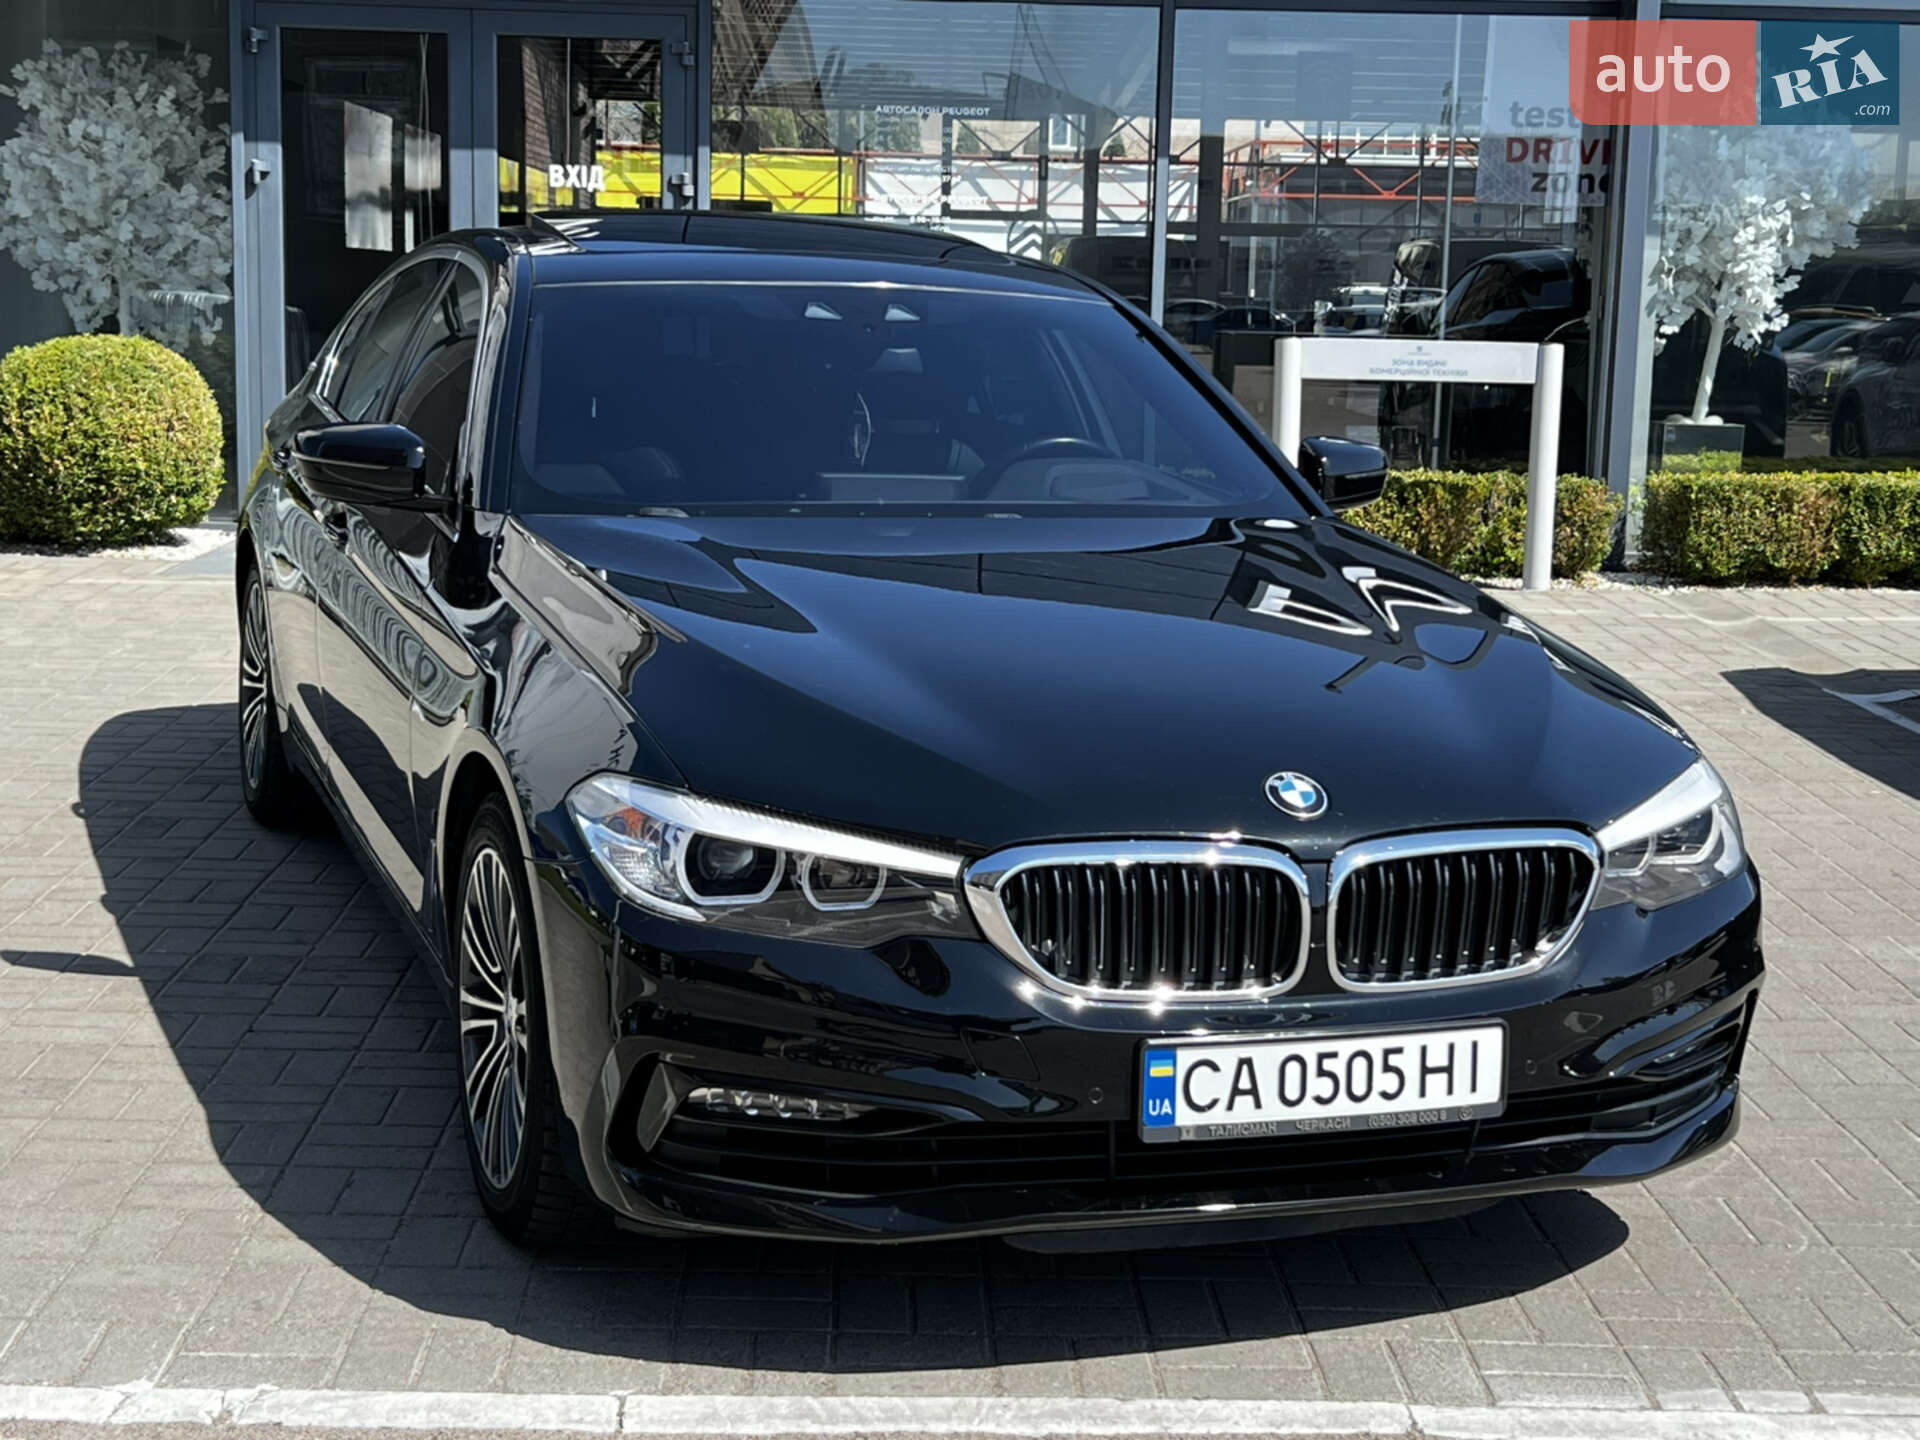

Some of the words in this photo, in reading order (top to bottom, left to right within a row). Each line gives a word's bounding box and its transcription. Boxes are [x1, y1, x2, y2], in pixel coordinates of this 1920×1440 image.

[942, 106, 991, 116] PEUGEOT
[549, 164, 606, 192] ВХІД
[1182, 1056, 1263, 1114] CA
[1277, 1046, 1406, 1108] 0505
[1419, 1039, 1479, 1099] HI
[1149, 1100, 1172, 1115] UA
[1295, 1117, 1352, 1132] ЧЕРКАСИ
